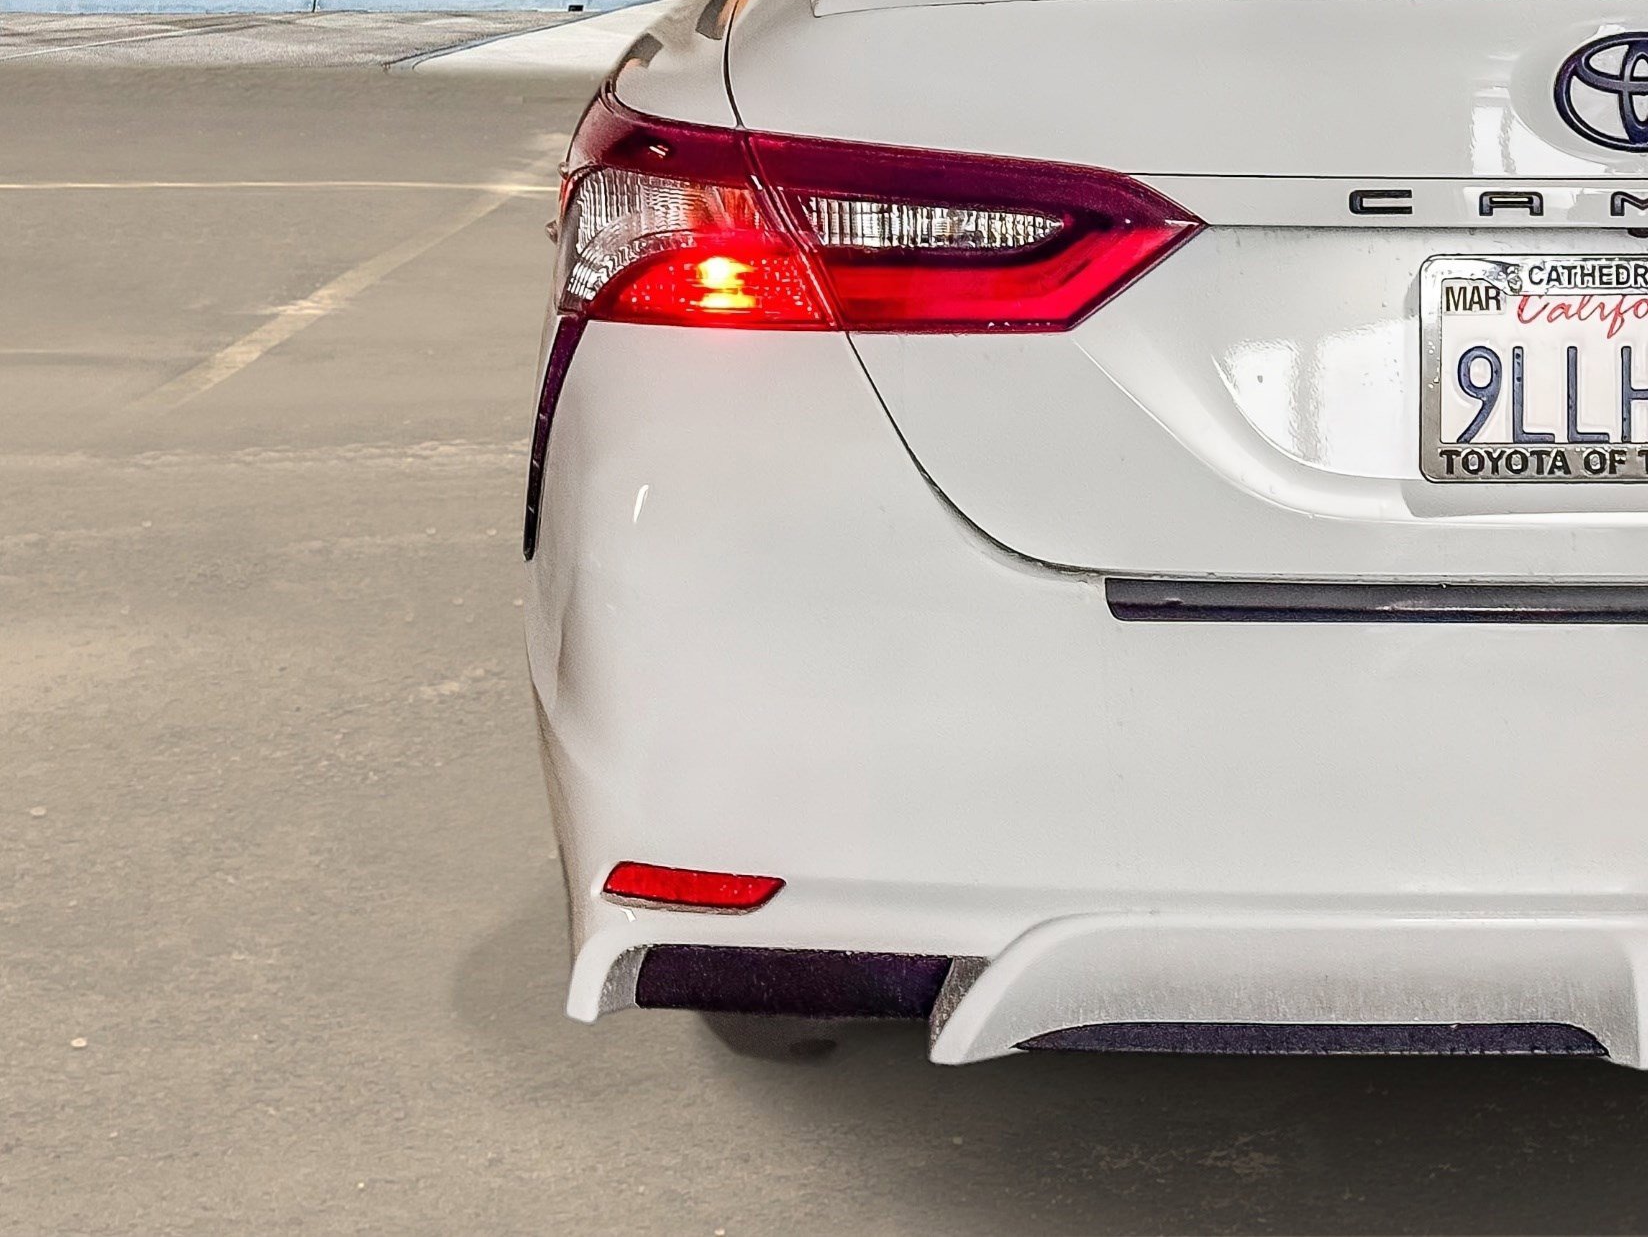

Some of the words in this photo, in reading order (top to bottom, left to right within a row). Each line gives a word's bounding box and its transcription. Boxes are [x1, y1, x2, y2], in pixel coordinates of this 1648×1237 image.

[1445, 285, 1502, 312] MAR
[1439, 448, 1573, 476] TOYOTA
[1583, 448, 1628, 476] OF
